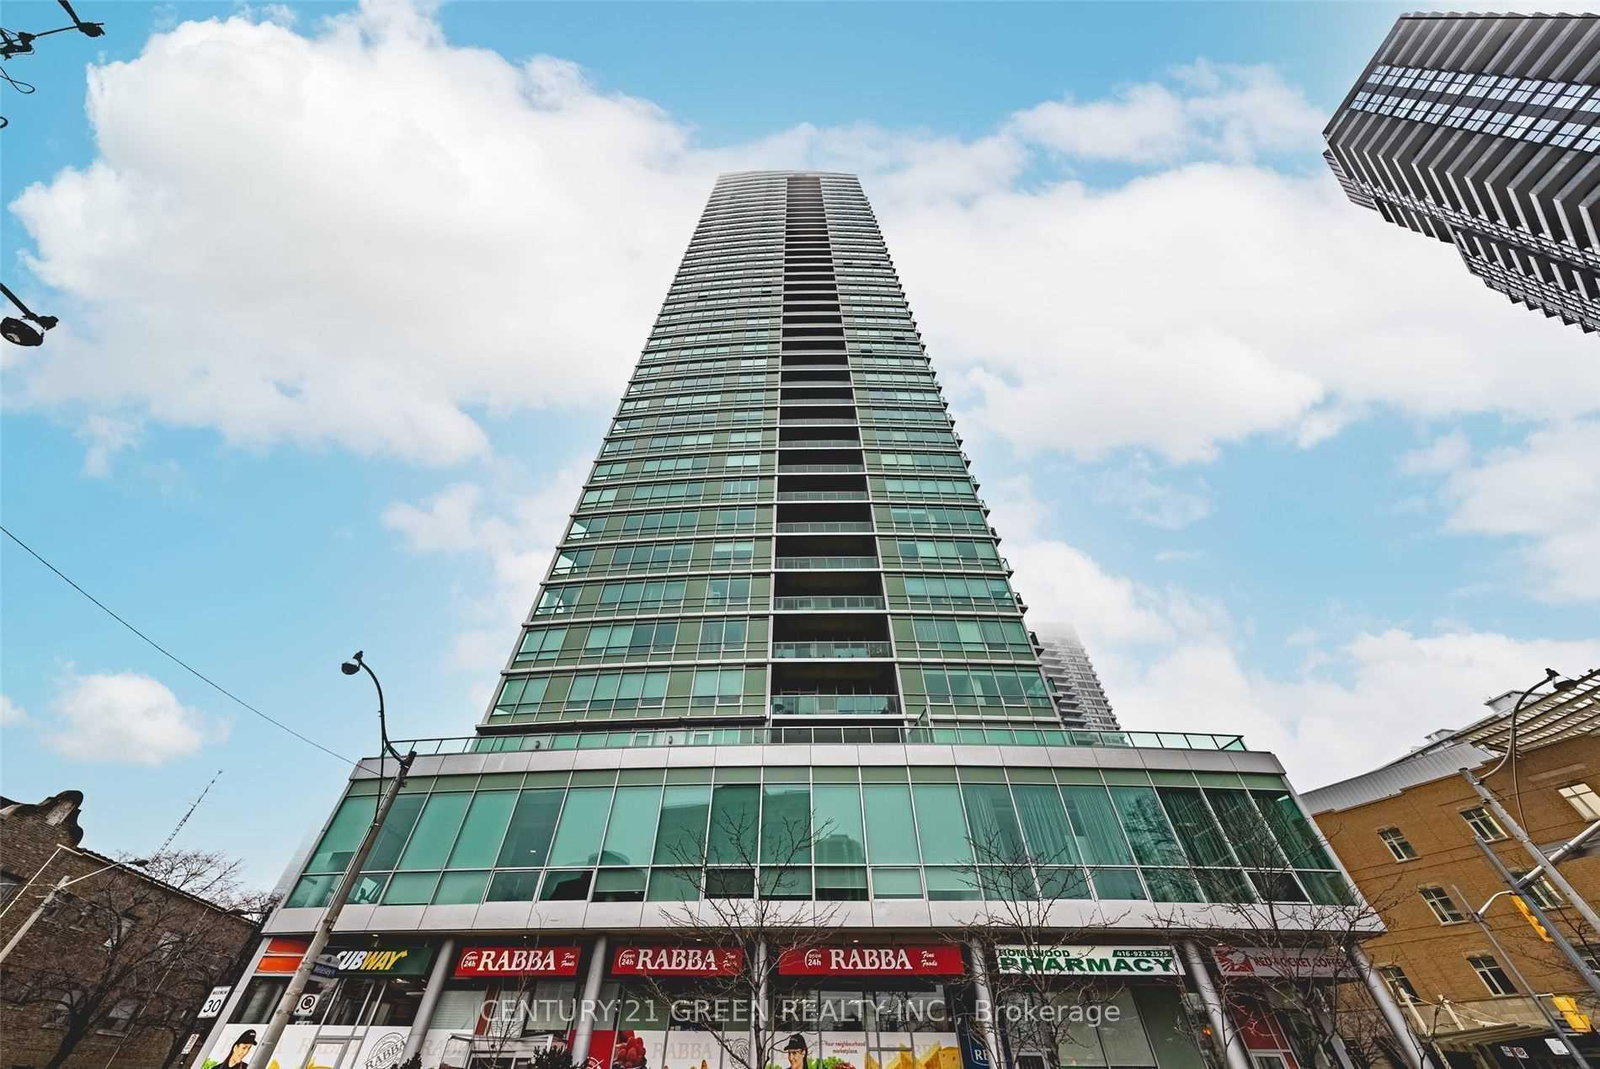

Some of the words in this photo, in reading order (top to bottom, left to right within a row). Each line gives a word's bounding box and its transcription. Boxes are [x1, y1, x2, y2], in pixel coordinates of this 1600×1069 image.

[337, 949, 408, 970] SUBWAY
[477, 950, 556, 971] RABBA
[621, 958, 634, 966] 24h
[635, 948, 718, 970] RABBA
[829, 948, 913, 970] RABBA
[921, 950, 935, 958] Fine
[464, 960, 477, 968] 24h
[999, 956, 1174, 972] PHARMACY
[203, 999, 222, 1013] 30
[365, 1040, 407, 1069] RABBA
